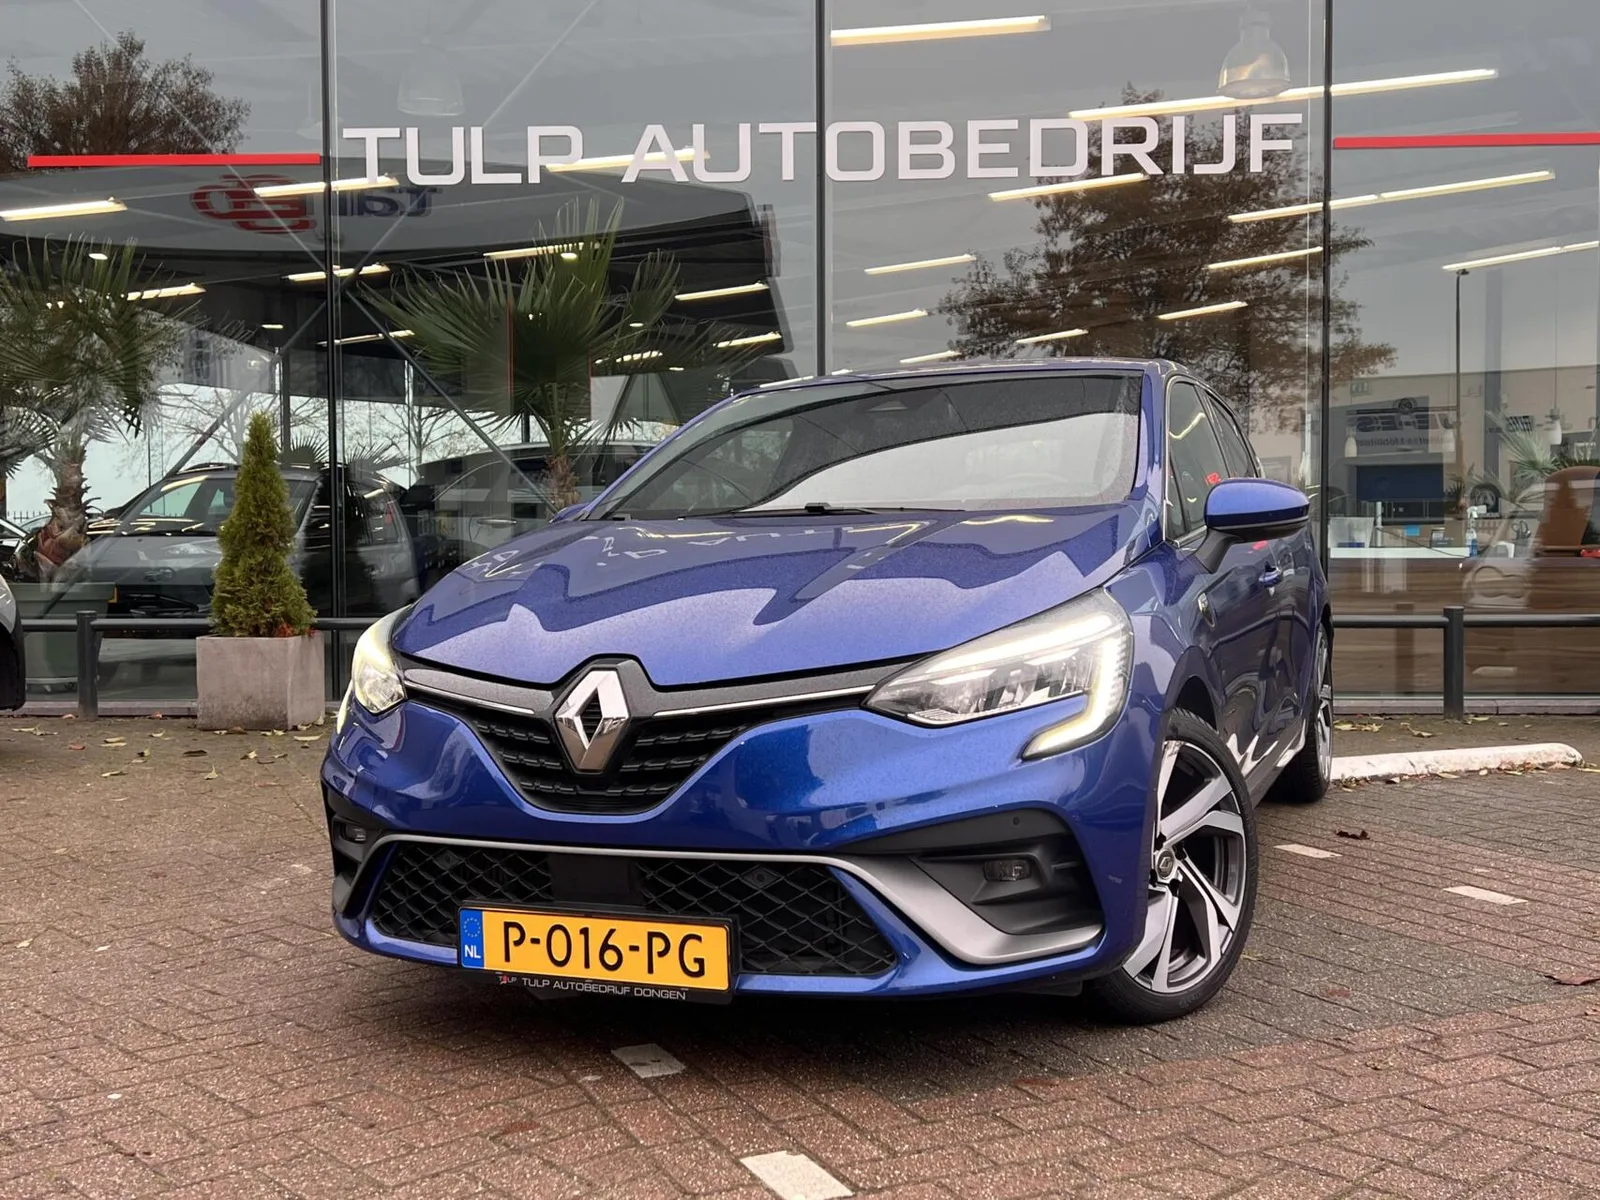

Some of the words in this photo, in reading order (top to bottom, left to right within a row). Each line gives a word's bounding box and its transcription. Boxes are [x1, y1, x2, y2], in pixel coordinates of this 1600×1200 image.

[342, 125, 584, 186] TULP
[621, 112, 1303, 185] AUTOBEDRIJF
[464, 944, 482, 959] NL
[503, 920, 706, 979] P-016-PG
[521, 977, 551, 988] TULP
[552, 980, 631, 995] AUTOBEDRIJF
[633, 986, 686, 1000] DONGEN
